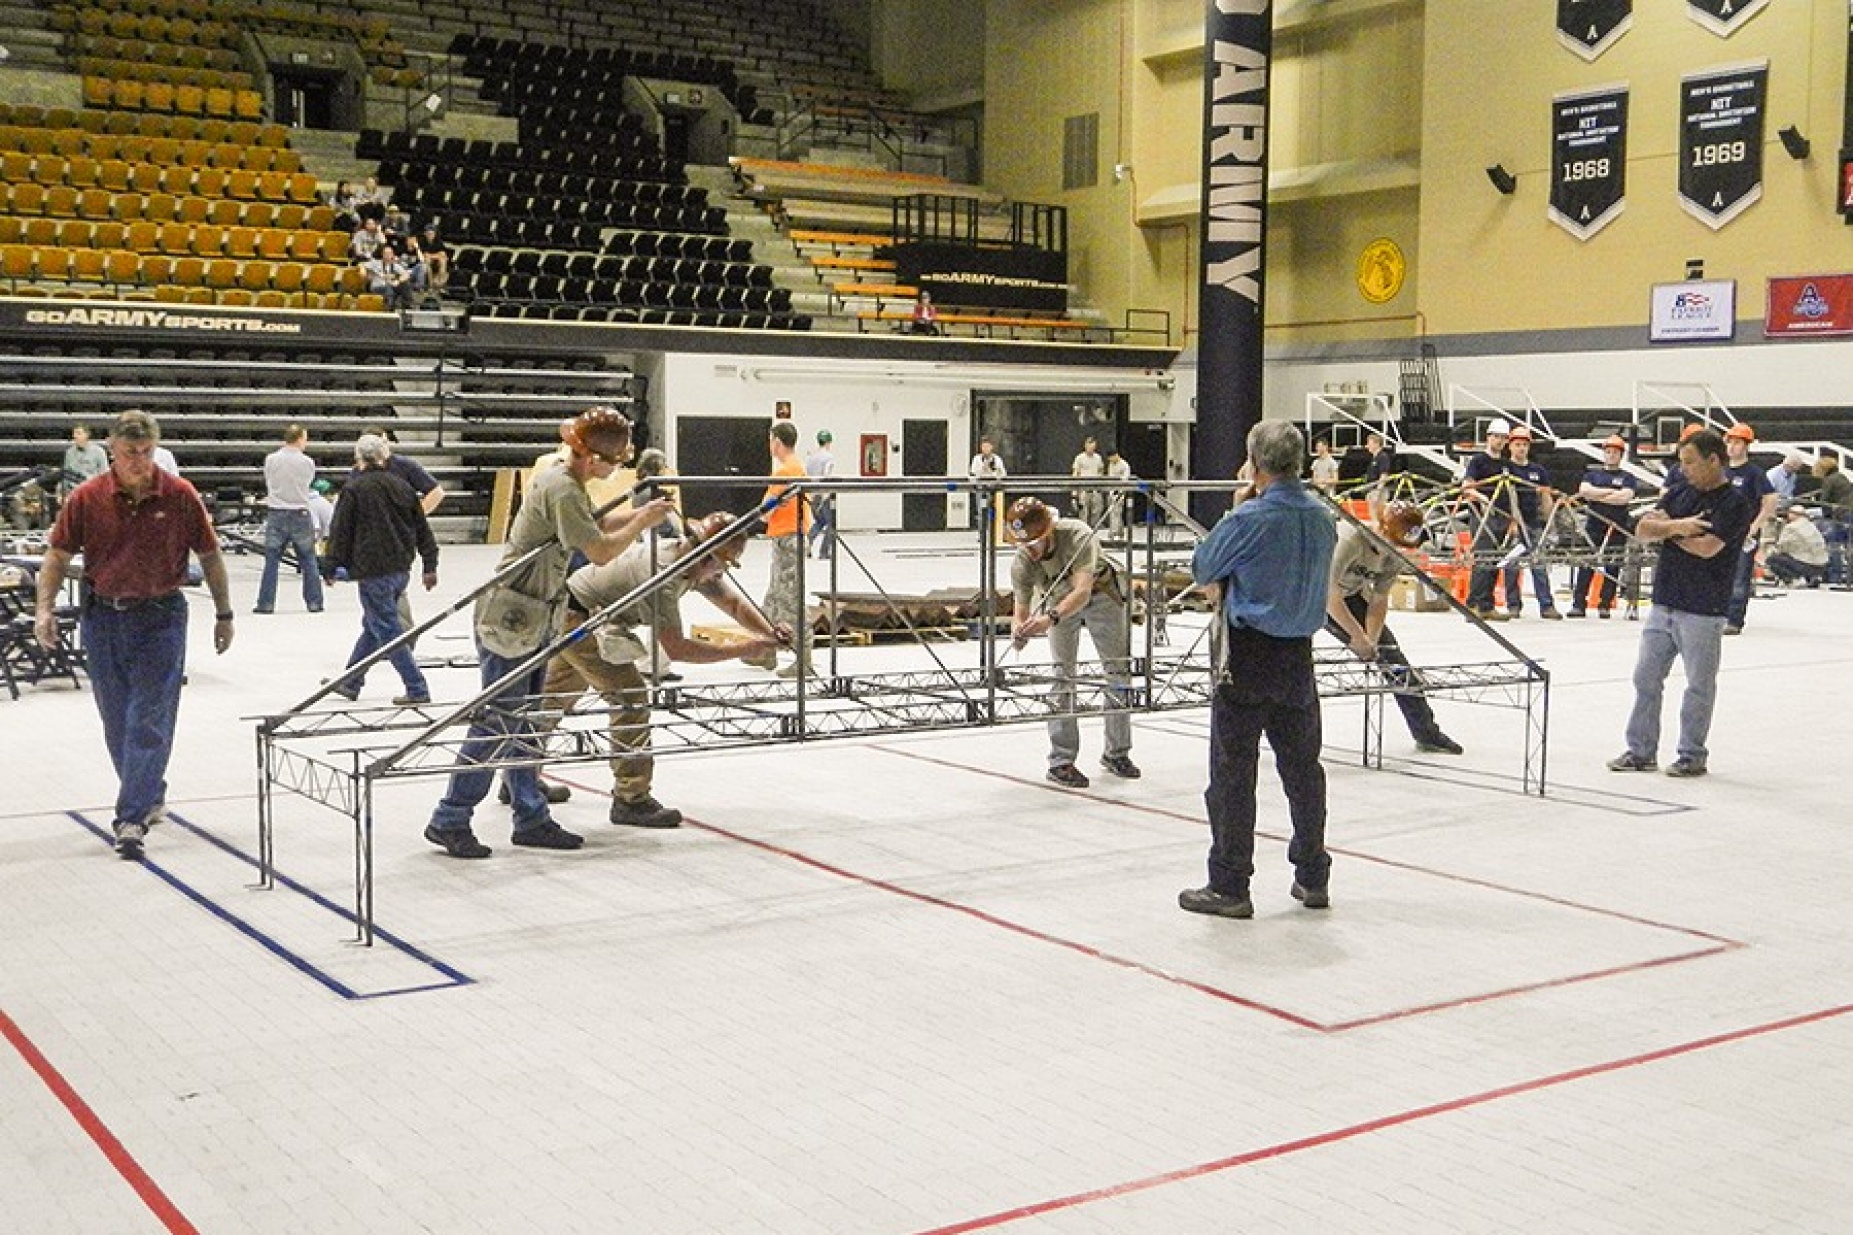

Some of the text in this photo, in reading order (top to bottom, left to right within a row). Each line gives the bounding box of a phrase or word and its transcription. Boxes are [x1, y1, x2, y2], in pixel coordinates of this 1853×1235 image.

[1692, 141, 1746, 167] 1969
[1206, 38, 1267, 304] ARMY
[1562, 158, 1611, 182] 1968
